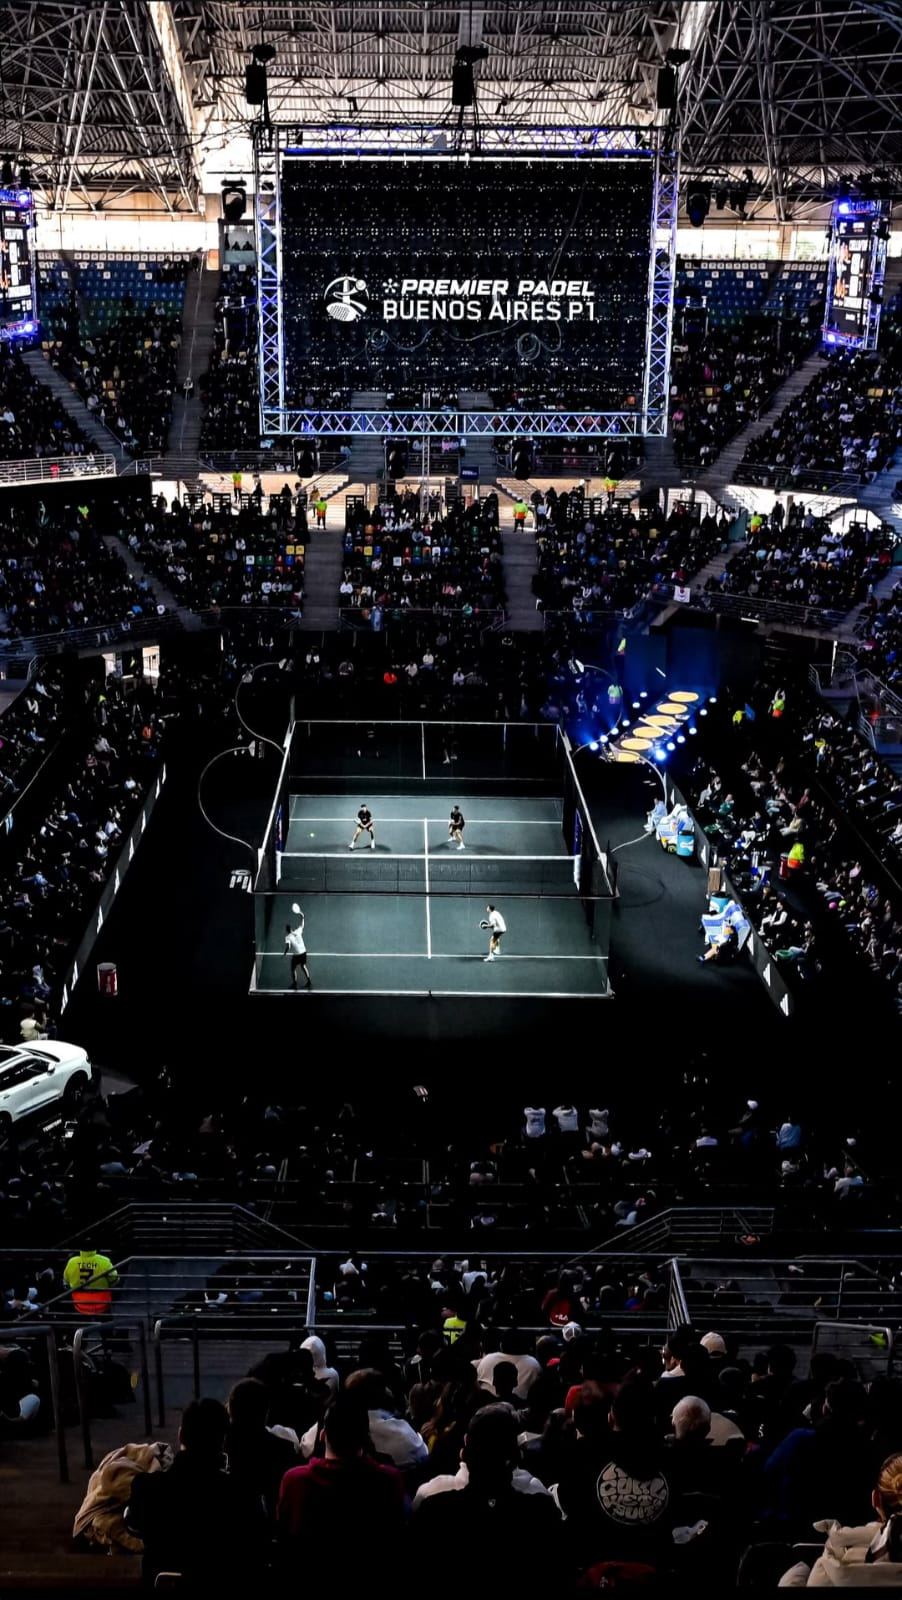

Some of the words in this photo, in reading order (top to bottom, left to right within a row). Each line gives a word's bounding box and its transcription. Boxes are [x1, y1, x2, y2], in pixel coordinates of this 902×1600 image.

[401, 279, 509, 296] PREMIER
[517, 280, 595, 297] PADEL
[383, 301, 482, 322] BUENOS
[488, 301, 562, 322] AIRES
[569, 301, 594, 322] P1
